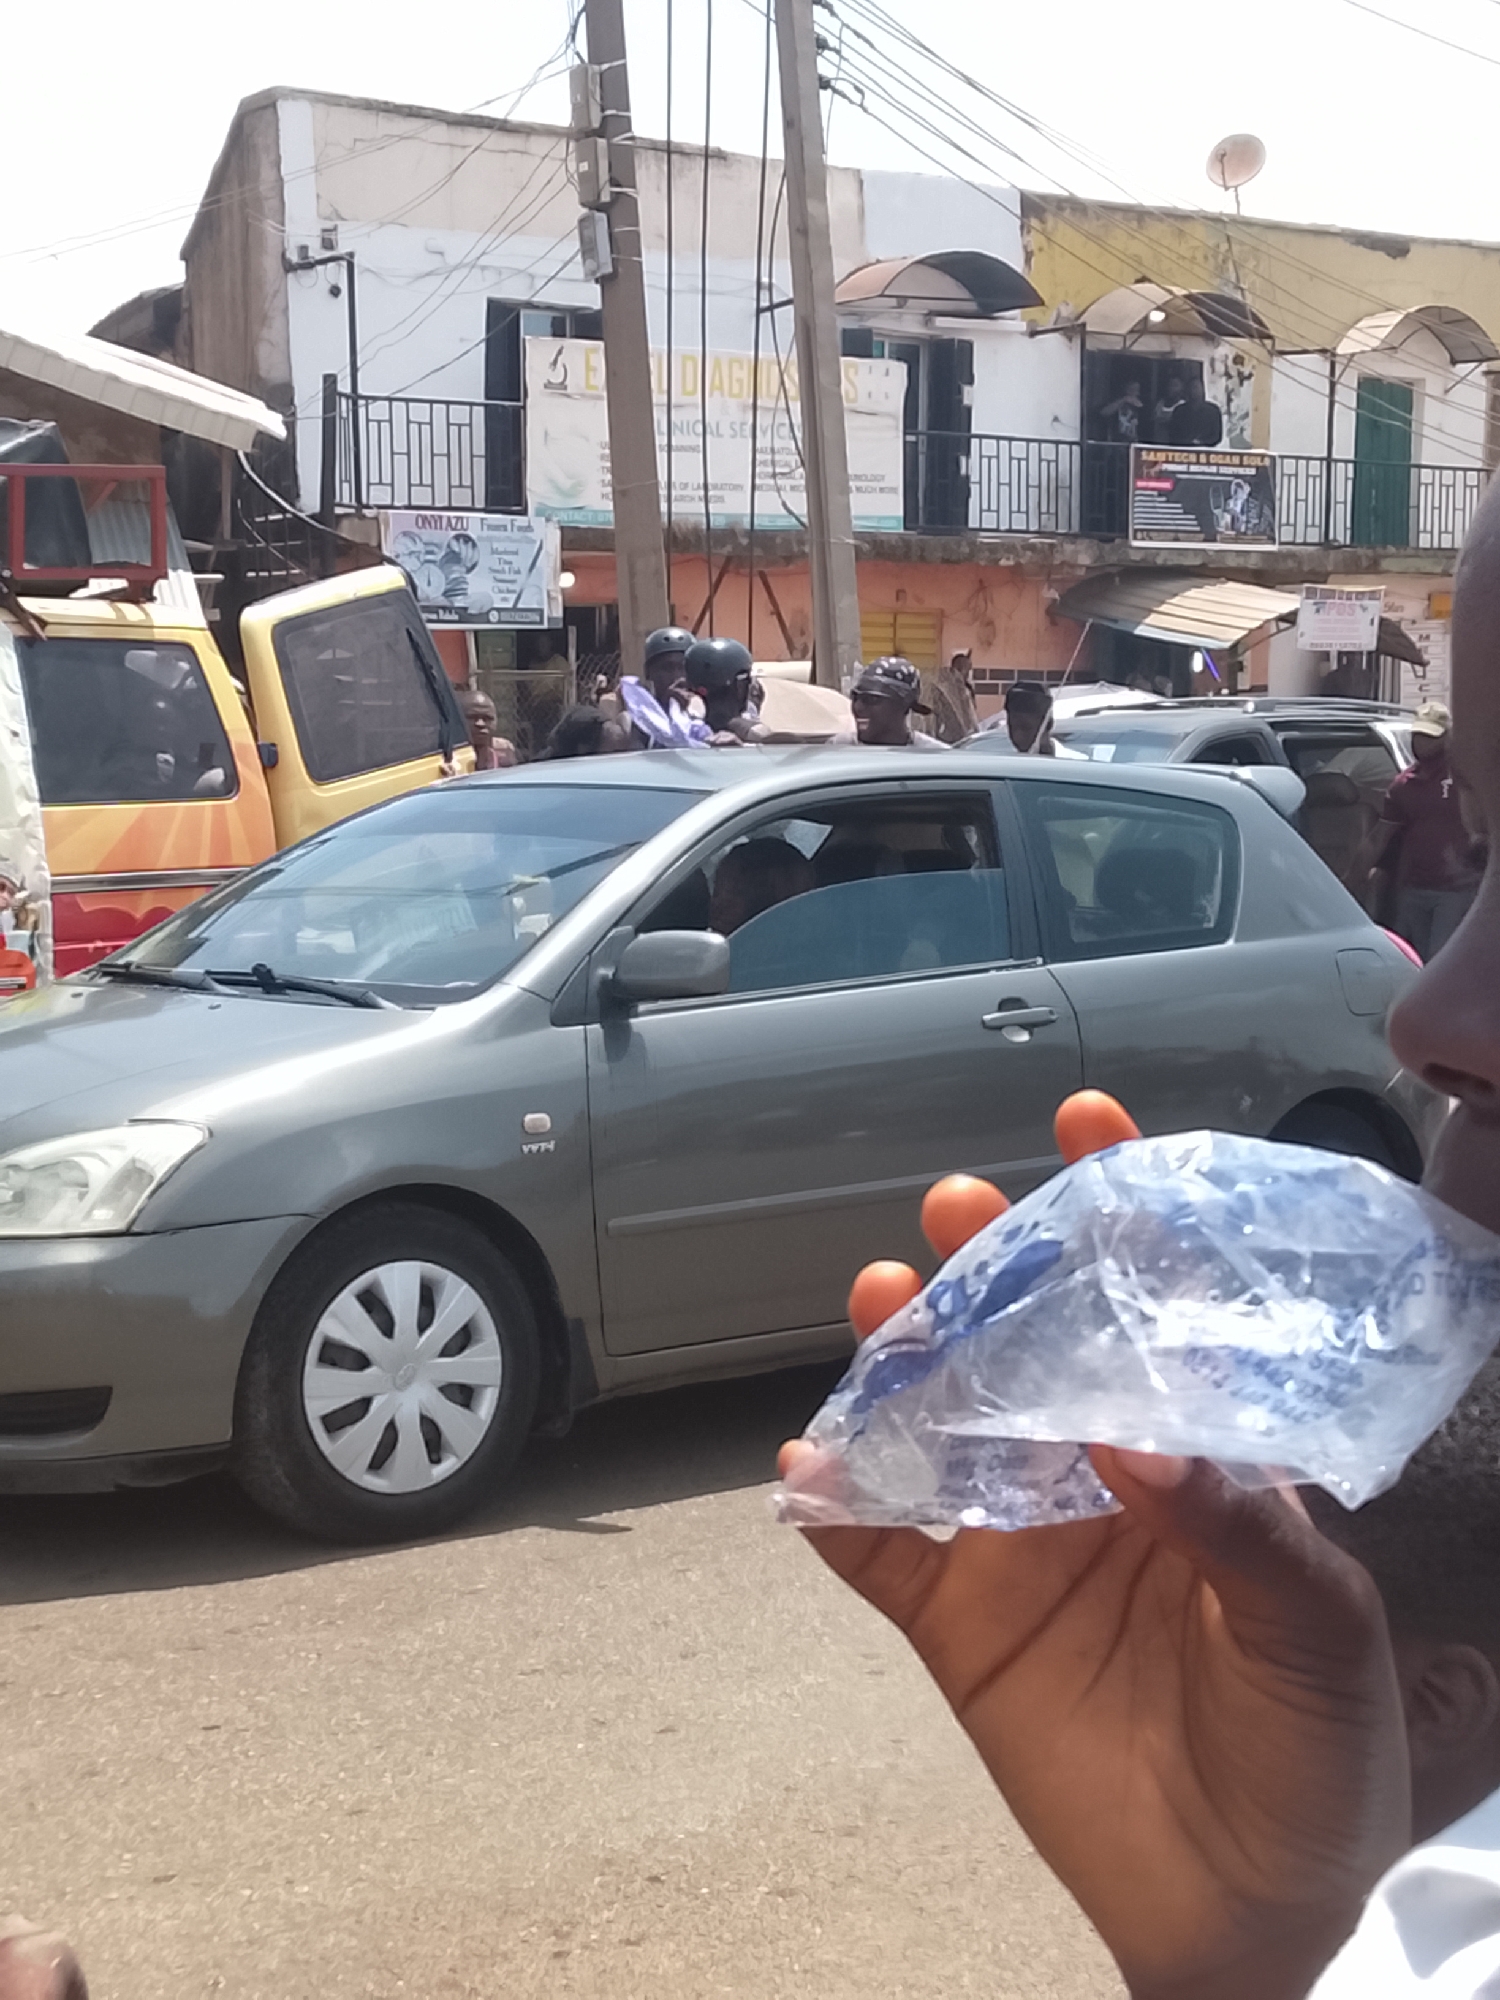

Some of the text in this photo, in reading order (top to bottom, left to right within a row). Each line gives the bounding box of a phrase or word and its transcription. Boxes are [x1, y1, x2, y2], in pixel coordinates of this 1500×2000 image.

[681, 354, 858, 404] DAGNOSS
[655, 418, 802, 441] LNICAL SEVCE
[445, 515, 470, 532] AZU
[1326, 601, 1356, 617] POS
